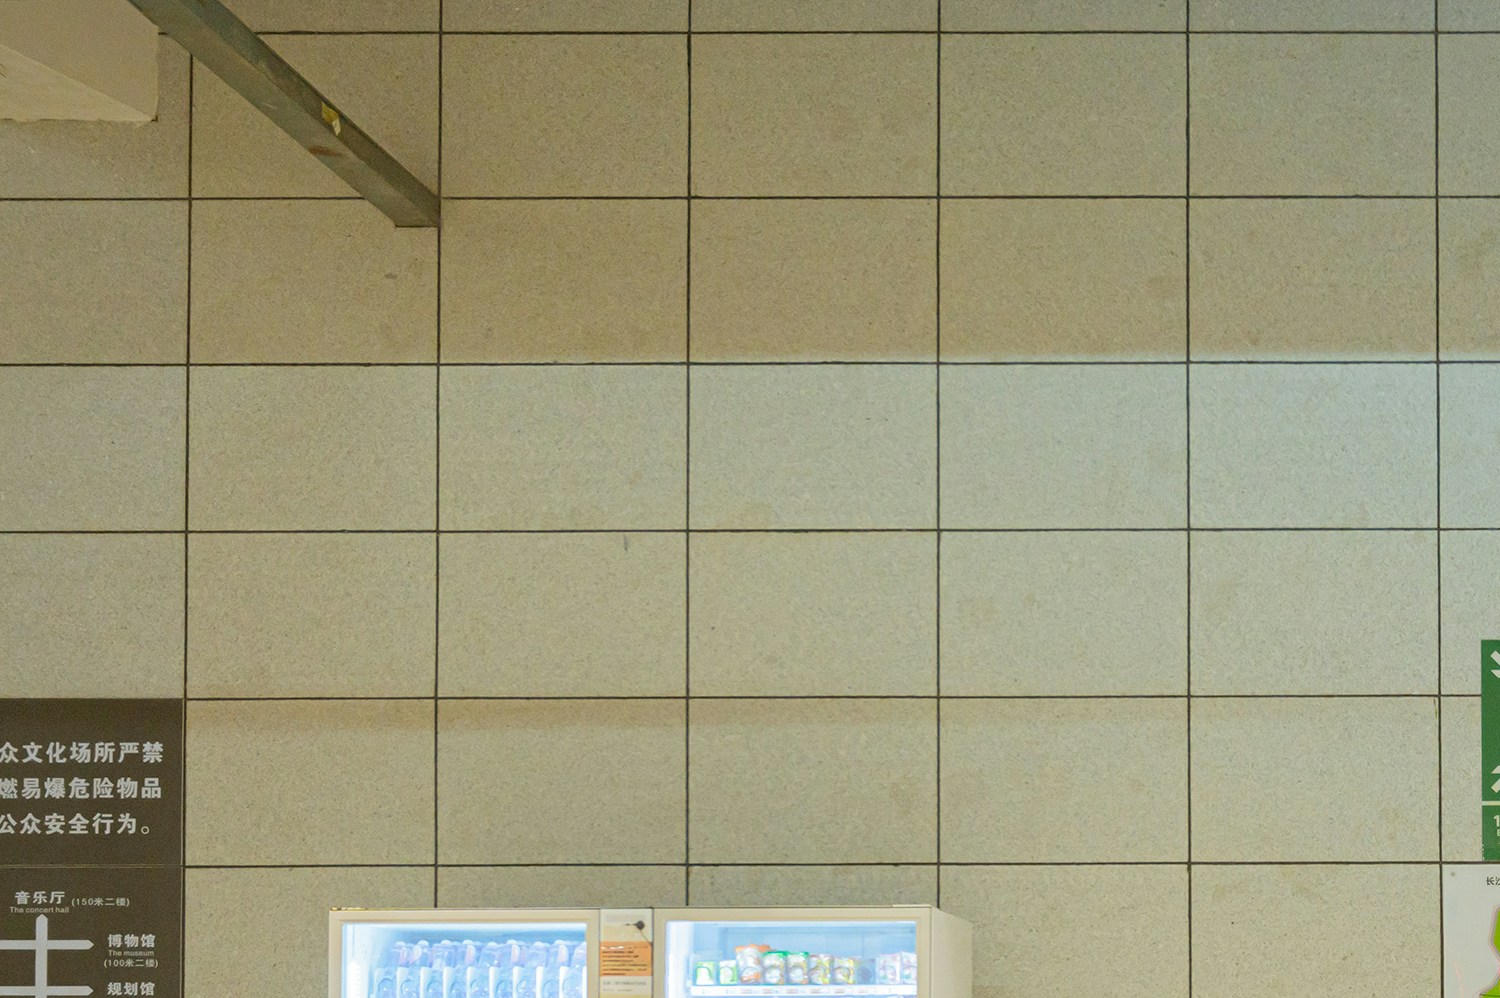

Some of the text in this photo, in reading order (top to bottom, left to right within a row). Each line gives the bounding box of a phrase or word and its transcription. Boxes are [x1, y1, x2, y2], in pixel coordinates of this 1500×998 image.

[0, 741, 164, 764] 众文化场所严禁
[0, 777, 162, 799] 燃易爆危险物品
[14, 891, 65, 905] 音乐厅
[107, 933, 155, 948] 博物馆
[107, 981, 155, 996] 规划馆
